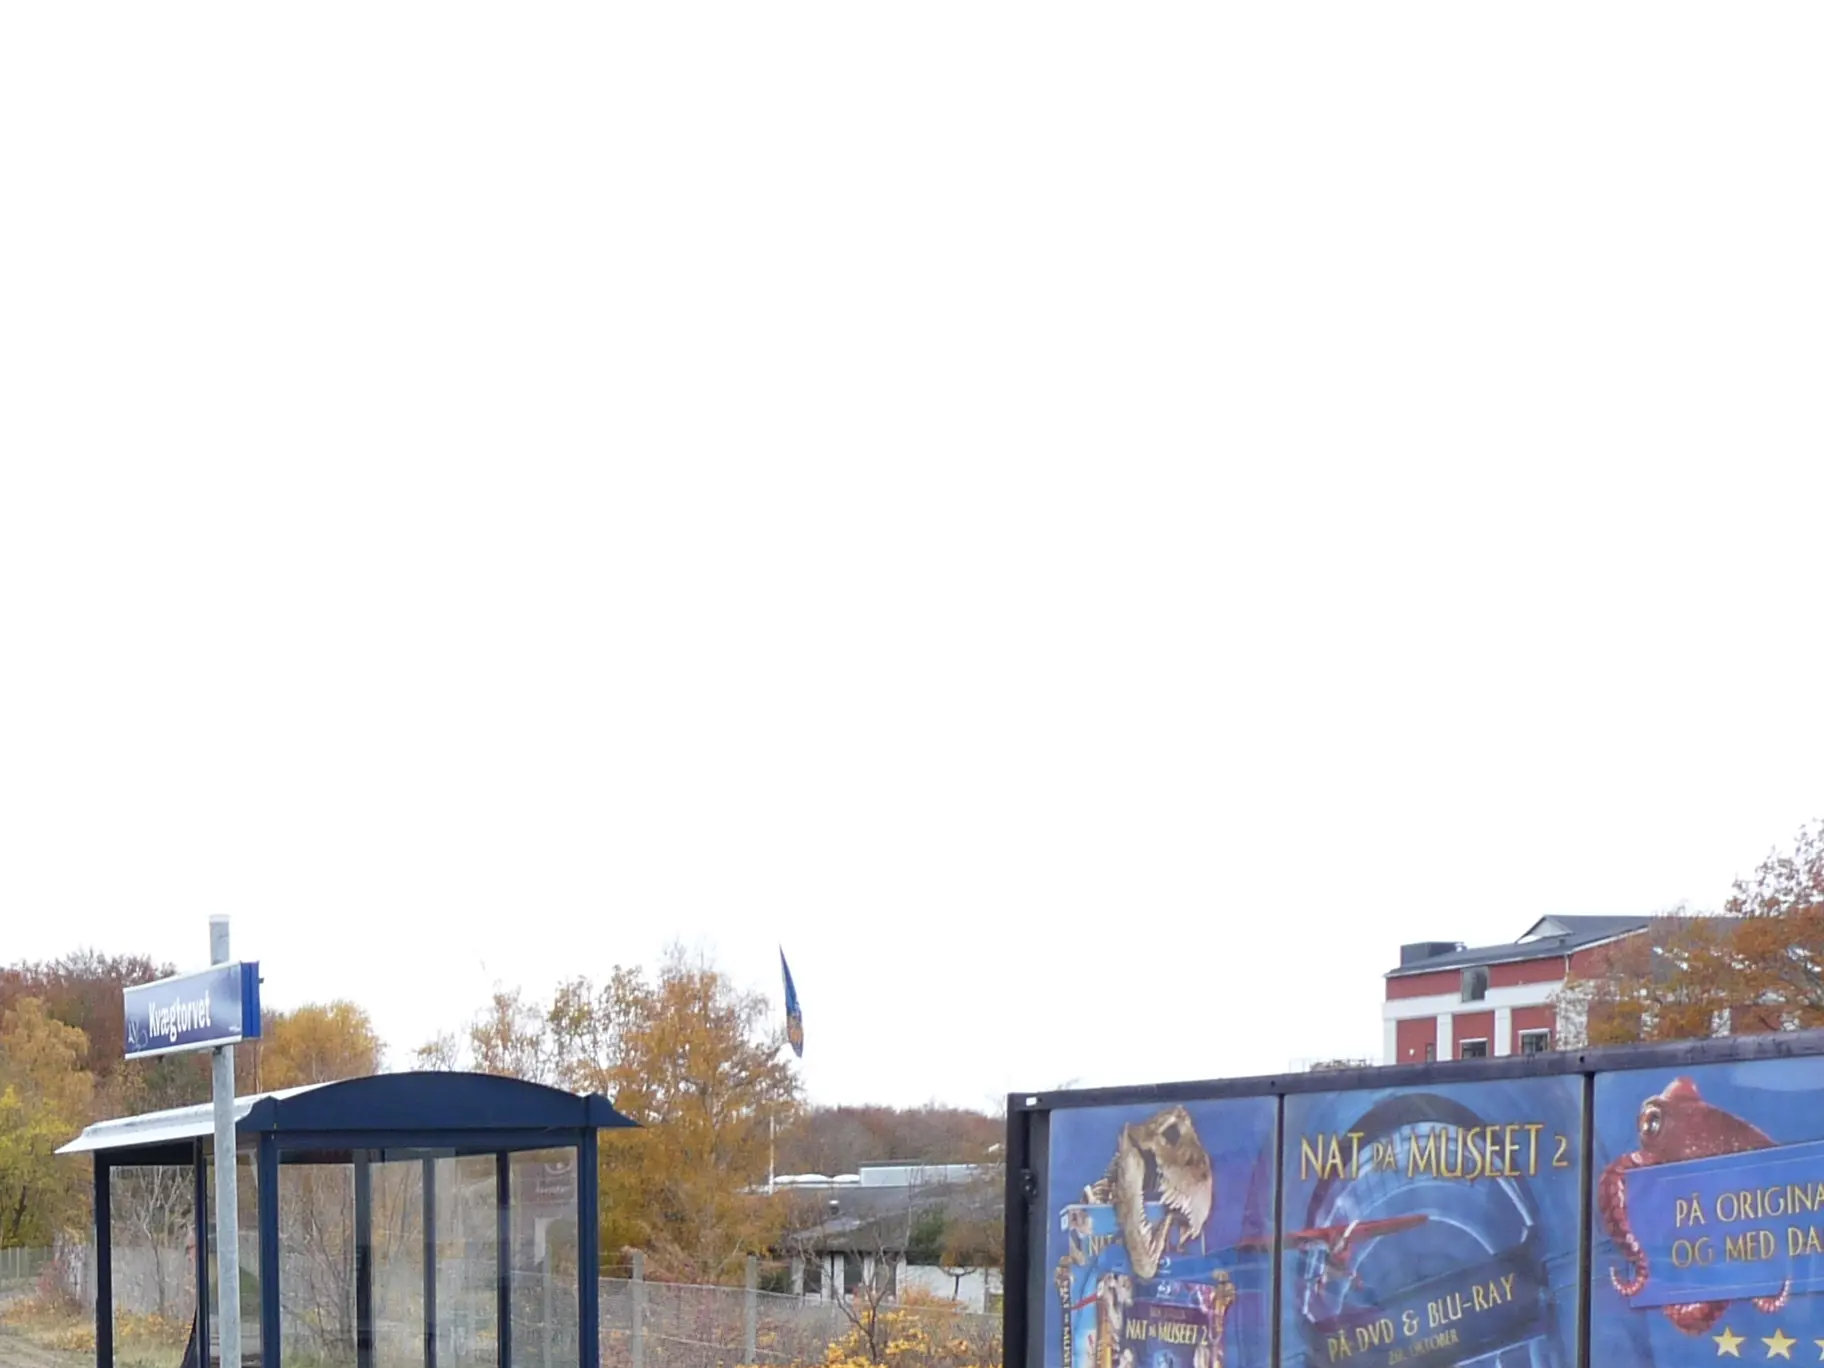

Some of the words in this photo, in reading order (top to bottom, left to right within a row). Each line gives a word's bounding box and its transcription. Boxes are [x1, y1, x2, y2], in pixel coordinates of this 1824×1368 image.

[148, 989, 210, 1042] Kvægtorvet
[1301, 1132, 1364, 1180] NAT
[1407, 1124, 1543, 1182] MUSEET
[1552, 1136, 1568, 1167] 2
[1676, 1192, 1706, 1228] PÅ
[1672, 1236, 1713, 1268] OG
[1726, 1230, 1775, 1262] MED
[1787, 1225, 1823, 1256] DA
[1126, 1319, 1148, 1341] NAT
[1158, 1321, 1198, 1345] MUSEET
[1201, 1326, 1209, 1346] 2
[1328, 1329, 1352, 1363] PÅ
[1356, 1318, 1394, 1352] DVD
[1402, 1309, 1419, 1336] &
[1428, 1273, 1515, 1328] BLU-RAY
